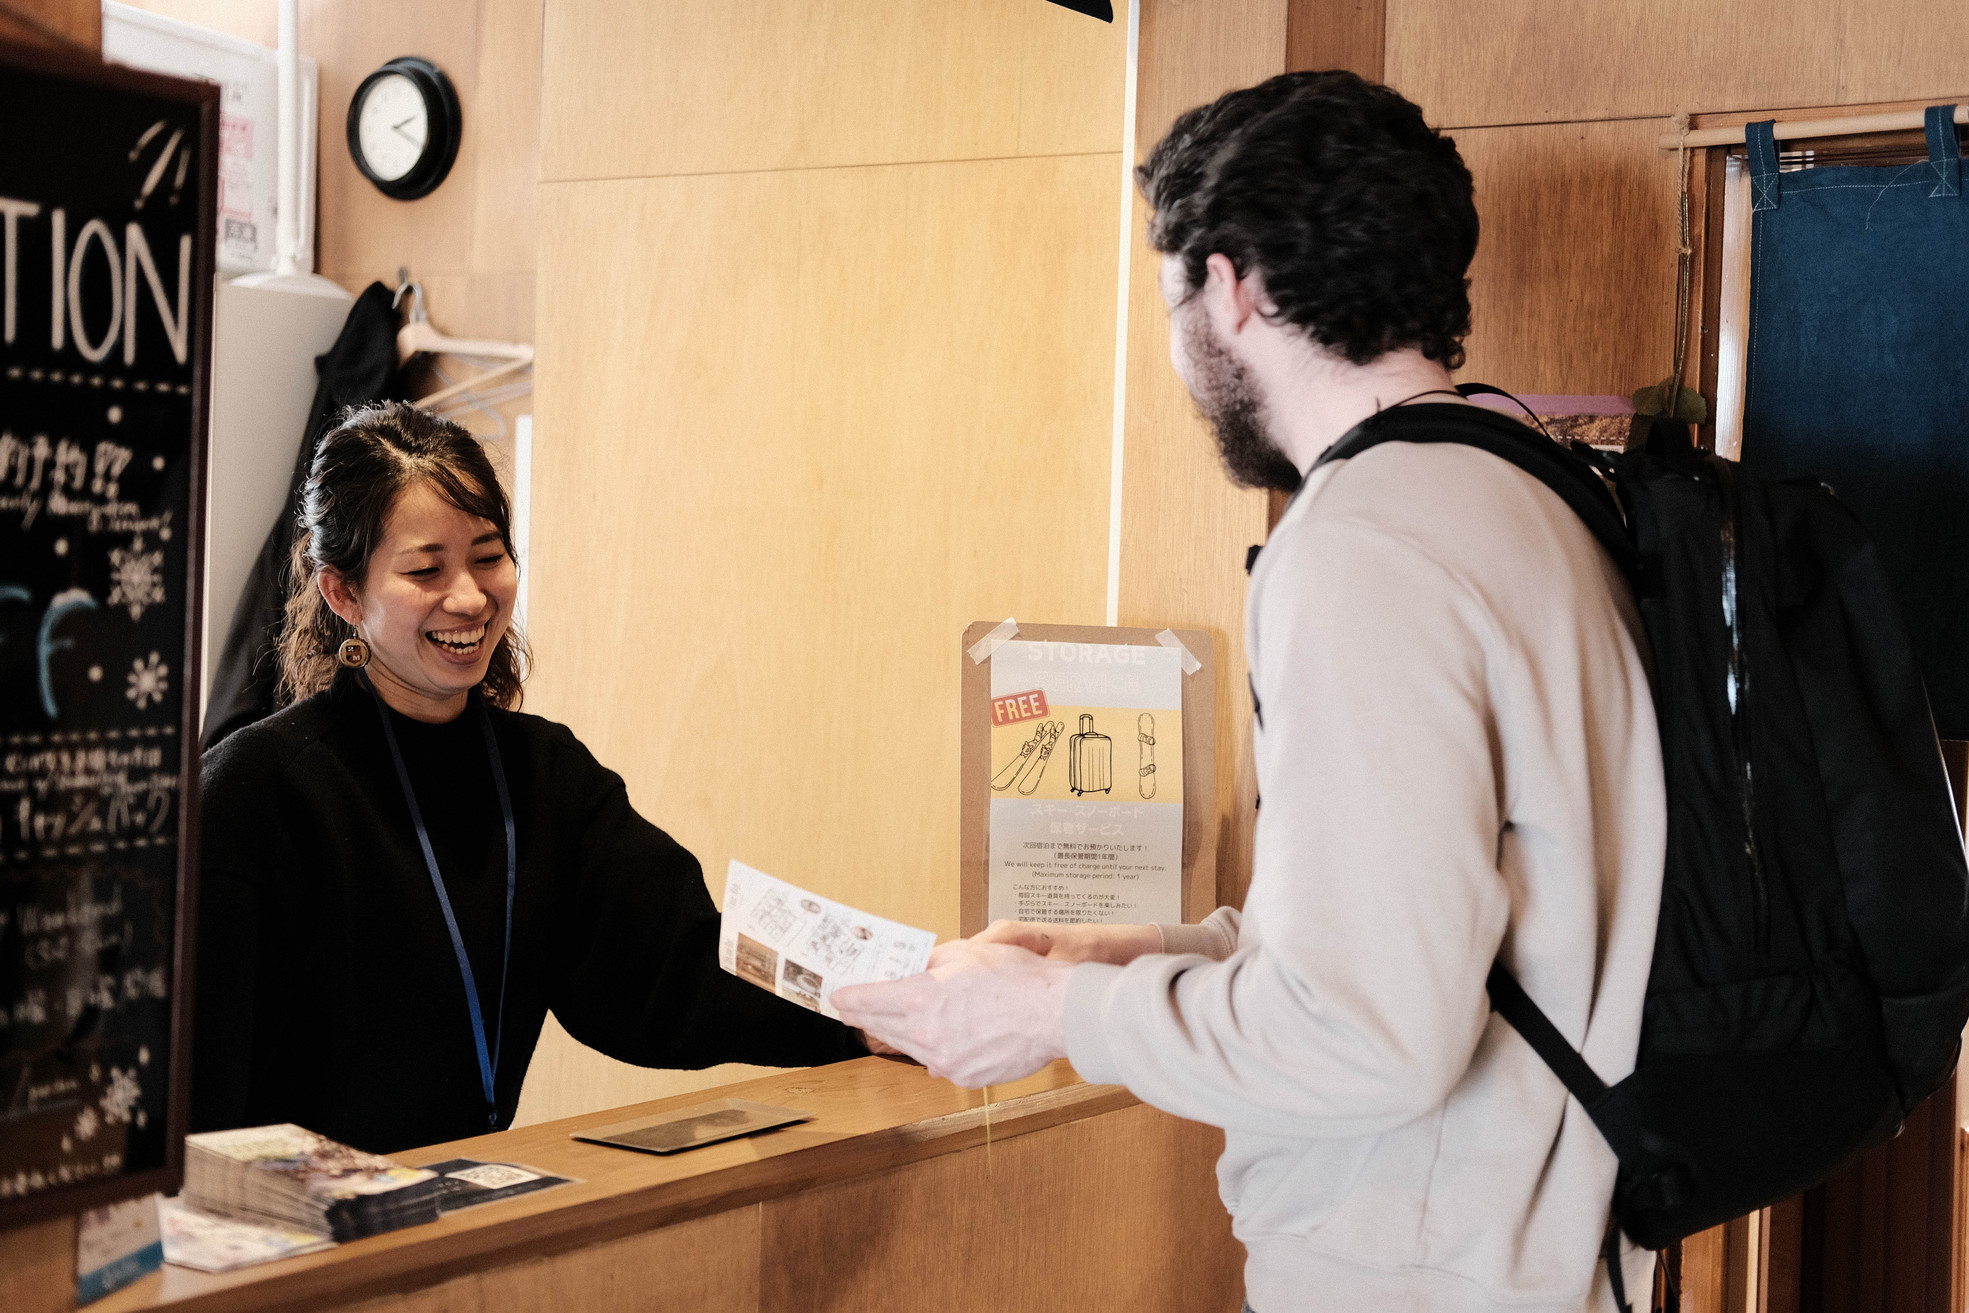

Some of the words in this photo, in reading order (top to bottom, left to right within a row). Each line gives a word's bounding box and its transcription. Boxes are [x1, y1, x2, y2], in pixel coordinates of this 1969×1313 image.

[1028, 642, 1146, 665] STORAGE
[993, 693, 1043, 723] FREE
[1029, 861, 1045, 869] keep
[1054, 861, 1069, 869] free
[1078, 862, 1100, 871] charge
[1101, 862, 1117, 870] until
[1065, 872, 1090, 880] storage
[1091, 872, 1115, 880] period:
[1122, 873, 1140, 881] year)
